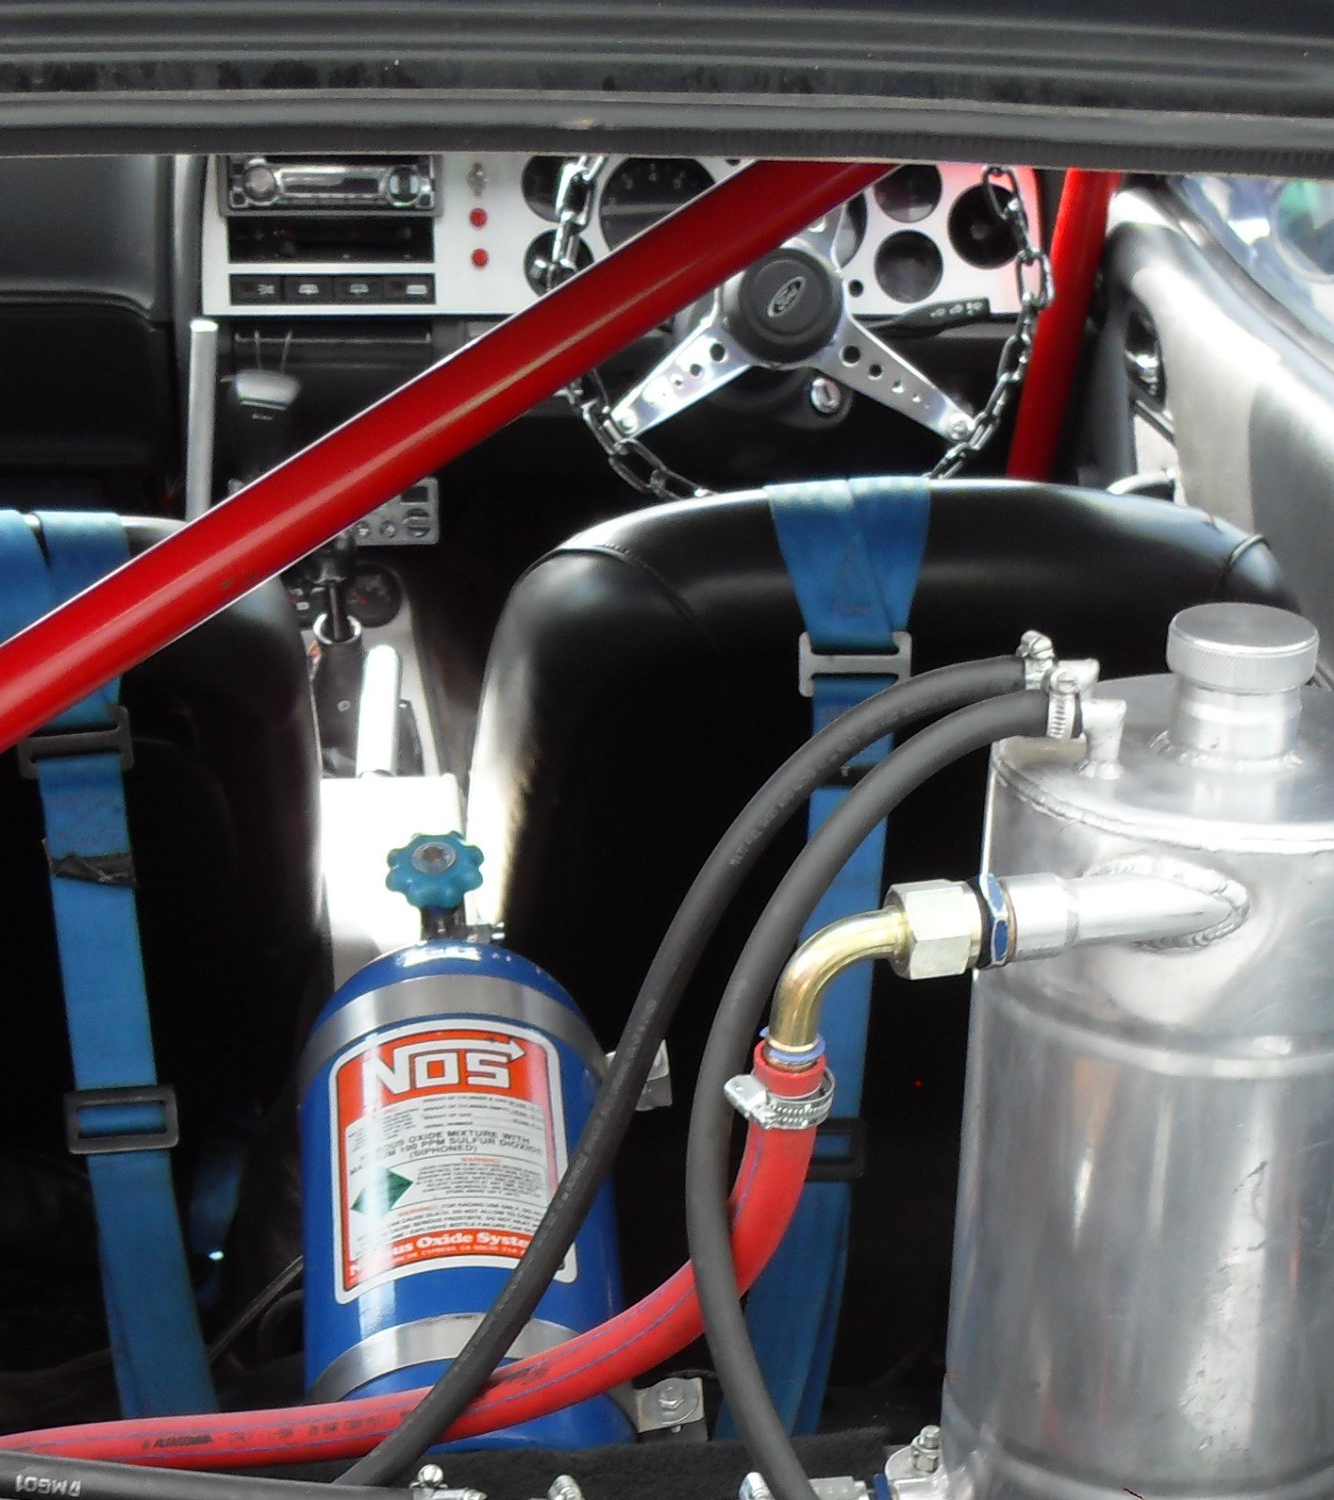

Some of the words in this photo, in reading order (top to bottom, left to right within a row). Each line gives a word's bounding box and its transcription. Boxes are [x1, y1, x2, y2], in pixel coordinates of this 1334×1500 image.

[362, 1039, 524, 1106] NOS
[447, 1129, 498, 1139] MIXTURE
[417, 1230, 474, 1249] Oxide
[476, 1231, 532, 1250] Syste
